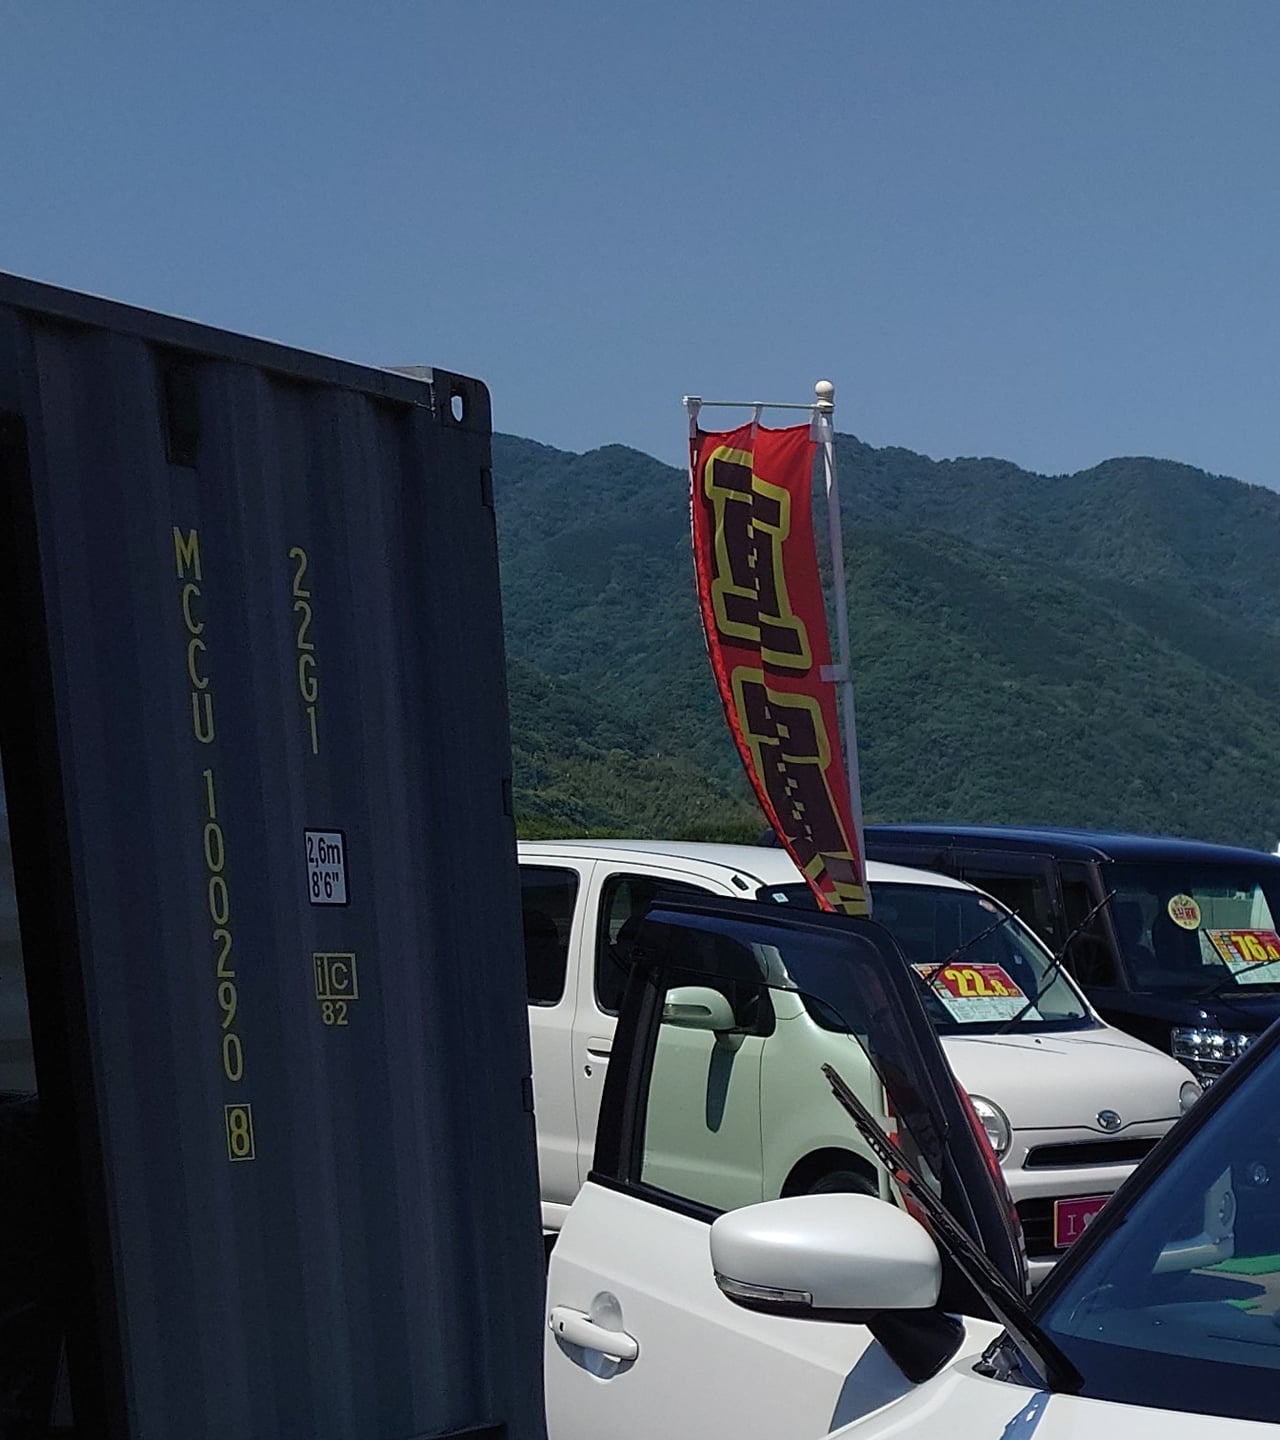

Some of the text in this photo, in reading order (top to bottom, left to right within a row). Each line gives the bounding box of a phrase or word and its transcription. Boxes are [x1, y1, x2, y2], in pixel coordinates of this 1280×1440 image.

[289, 547, 320, 755] 22G1
[172, 527, 251, 1156] MCCU 100290 8
[307, 837, 341, 868] 2,6m
[322, 1001, 348, 1026] 82
